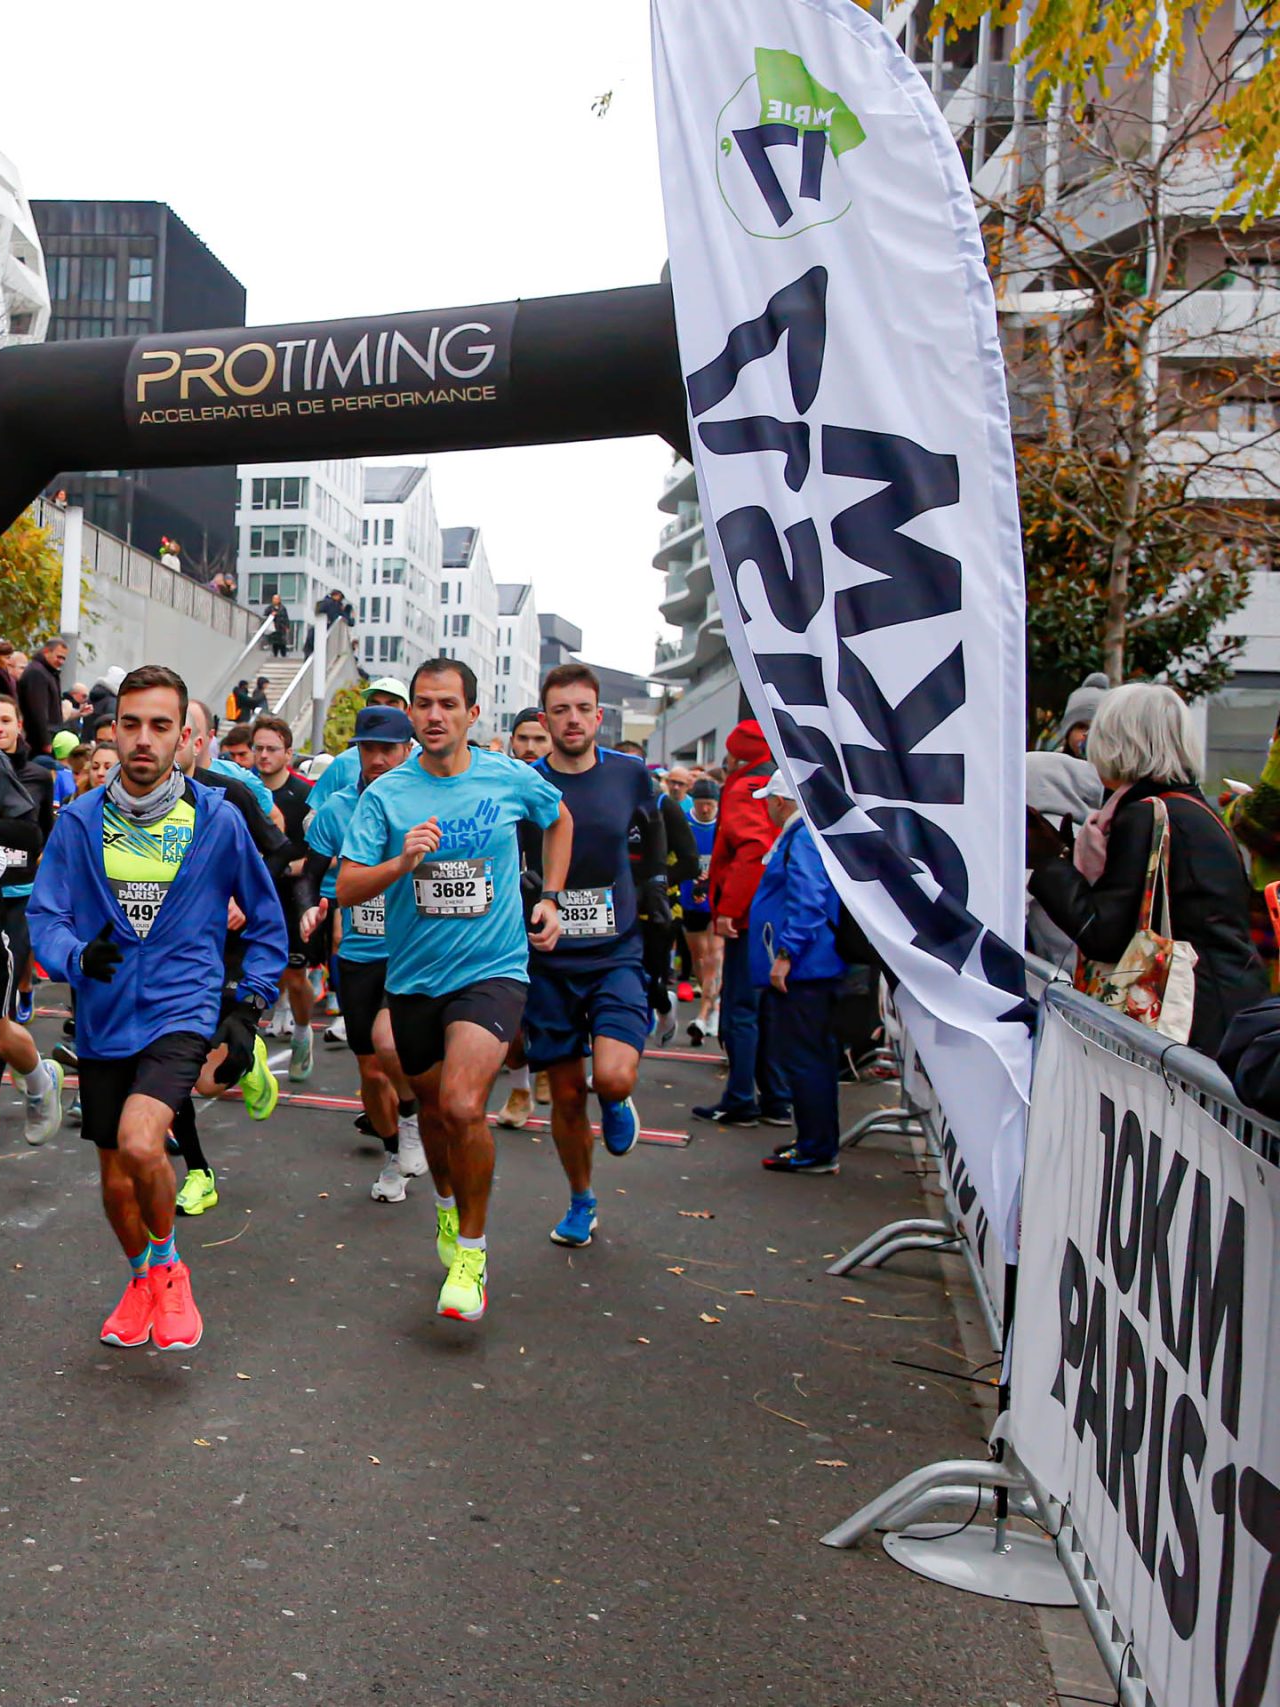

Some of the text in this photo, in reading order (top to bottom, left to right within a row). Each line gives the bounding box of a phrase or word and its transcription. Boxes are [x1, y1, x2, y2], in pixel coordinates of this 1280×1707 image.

[136, 322, 496, 402] PROTIMING
[139, 385, 497, 424] ACCELERATEUR DE PERFORMANCE
[439, 862, 470, 871] 10KM
[126, 882, 160, 891] 10KM
[432, 881, 476, 898] 3682
[566, 896, 599, 907] ARIS17
[561, 908, 598, 921] 3832
[1098, 1092, 1246, 1441] 10KM
